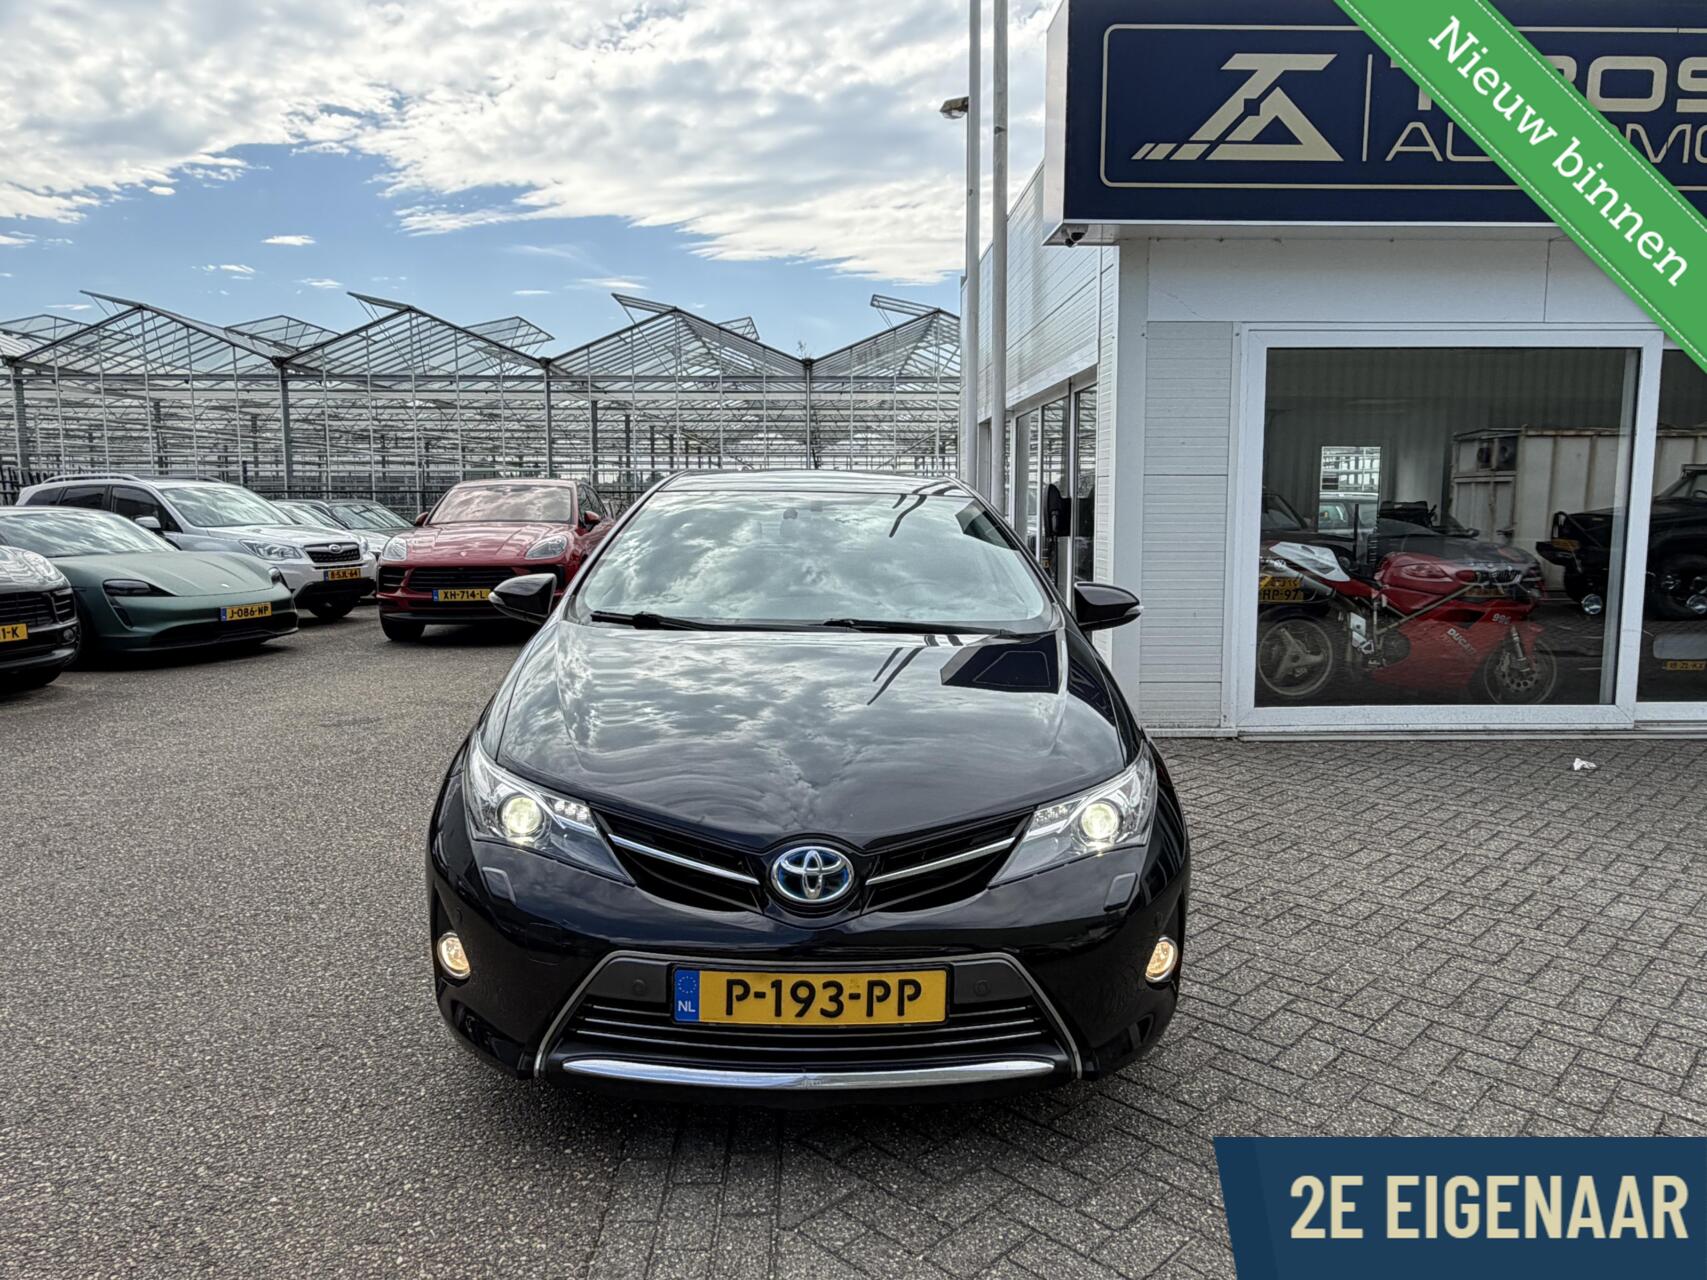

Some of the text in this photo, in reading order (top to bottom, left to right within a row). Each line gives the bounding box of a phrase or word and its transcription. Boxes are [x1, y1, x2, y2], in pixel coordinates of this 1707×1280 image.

[443, 590, 485, 600] XH-714-L
[677, 978, 922, 1019] NL P-193-PP
